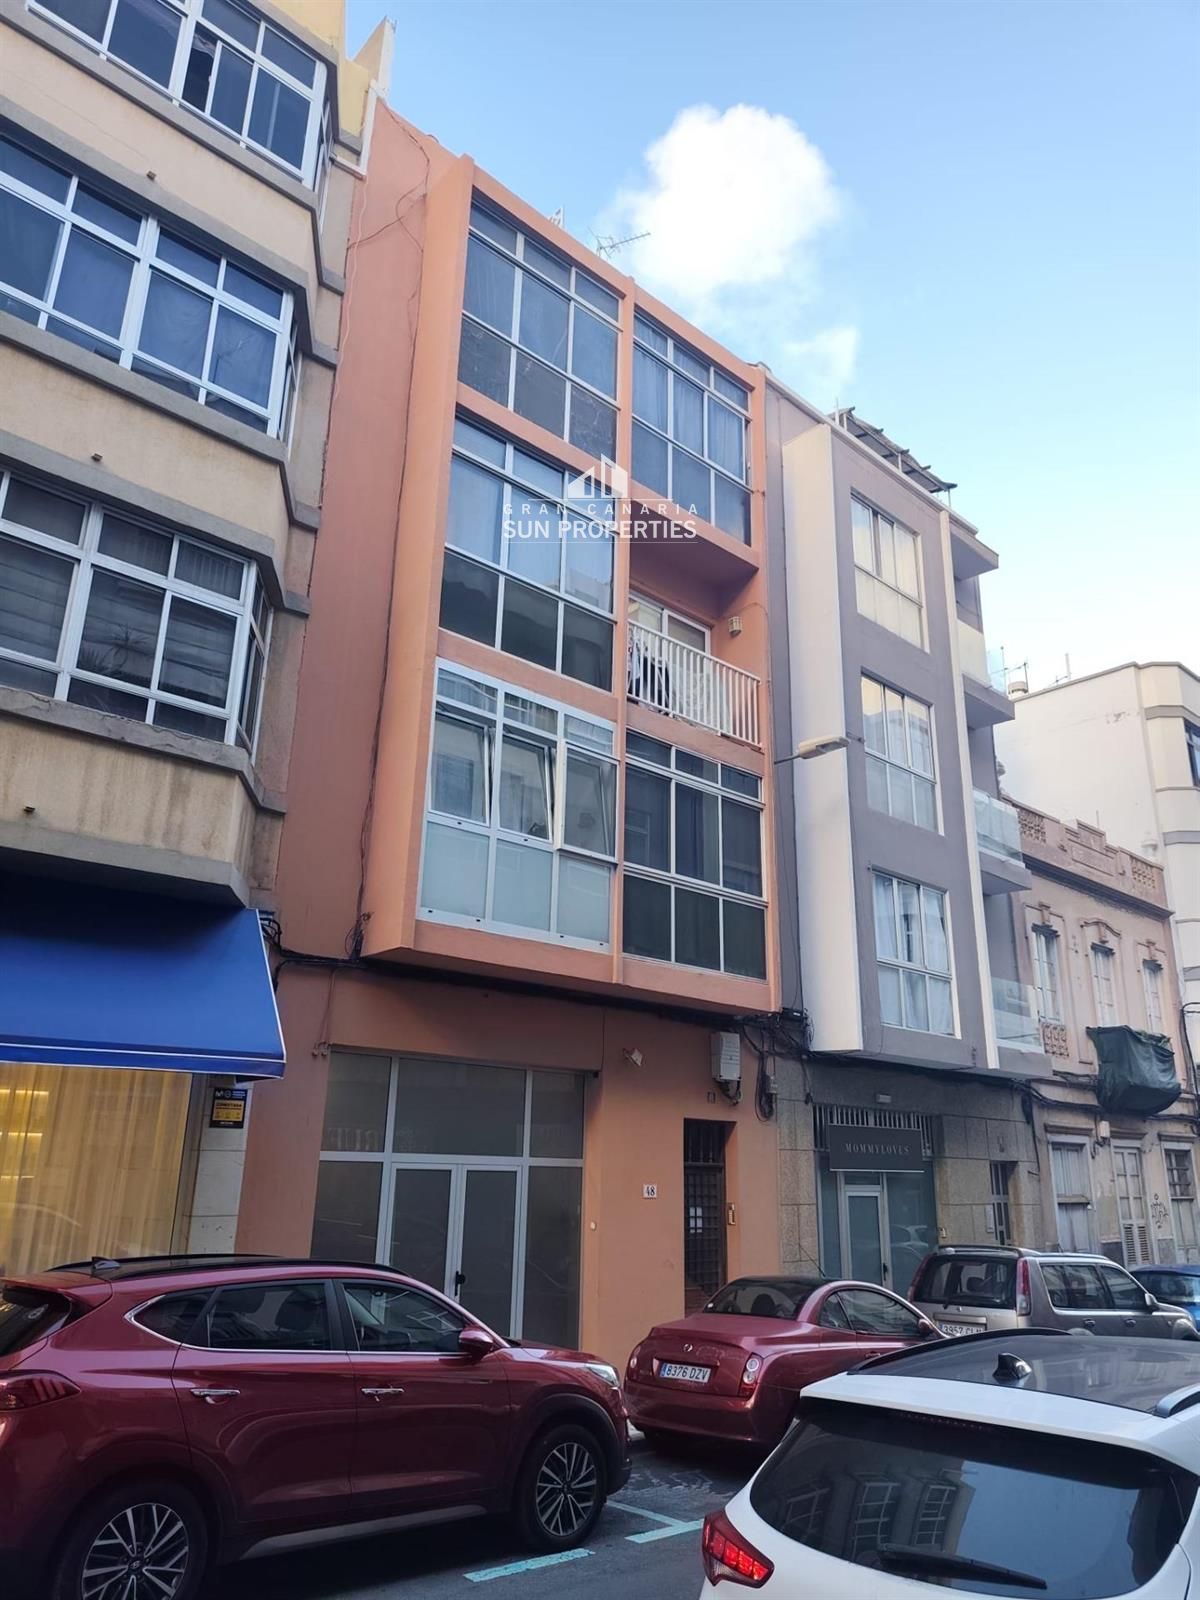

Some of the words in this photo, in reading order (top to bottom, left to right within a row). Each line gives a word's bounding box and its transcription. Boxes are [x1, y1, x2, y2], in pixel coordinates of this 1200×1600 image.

[645, 1186, 656, 1197] 48
[666, 1365, 688, 1378] 8376
[689, 1367, 708, 1380] DZV
